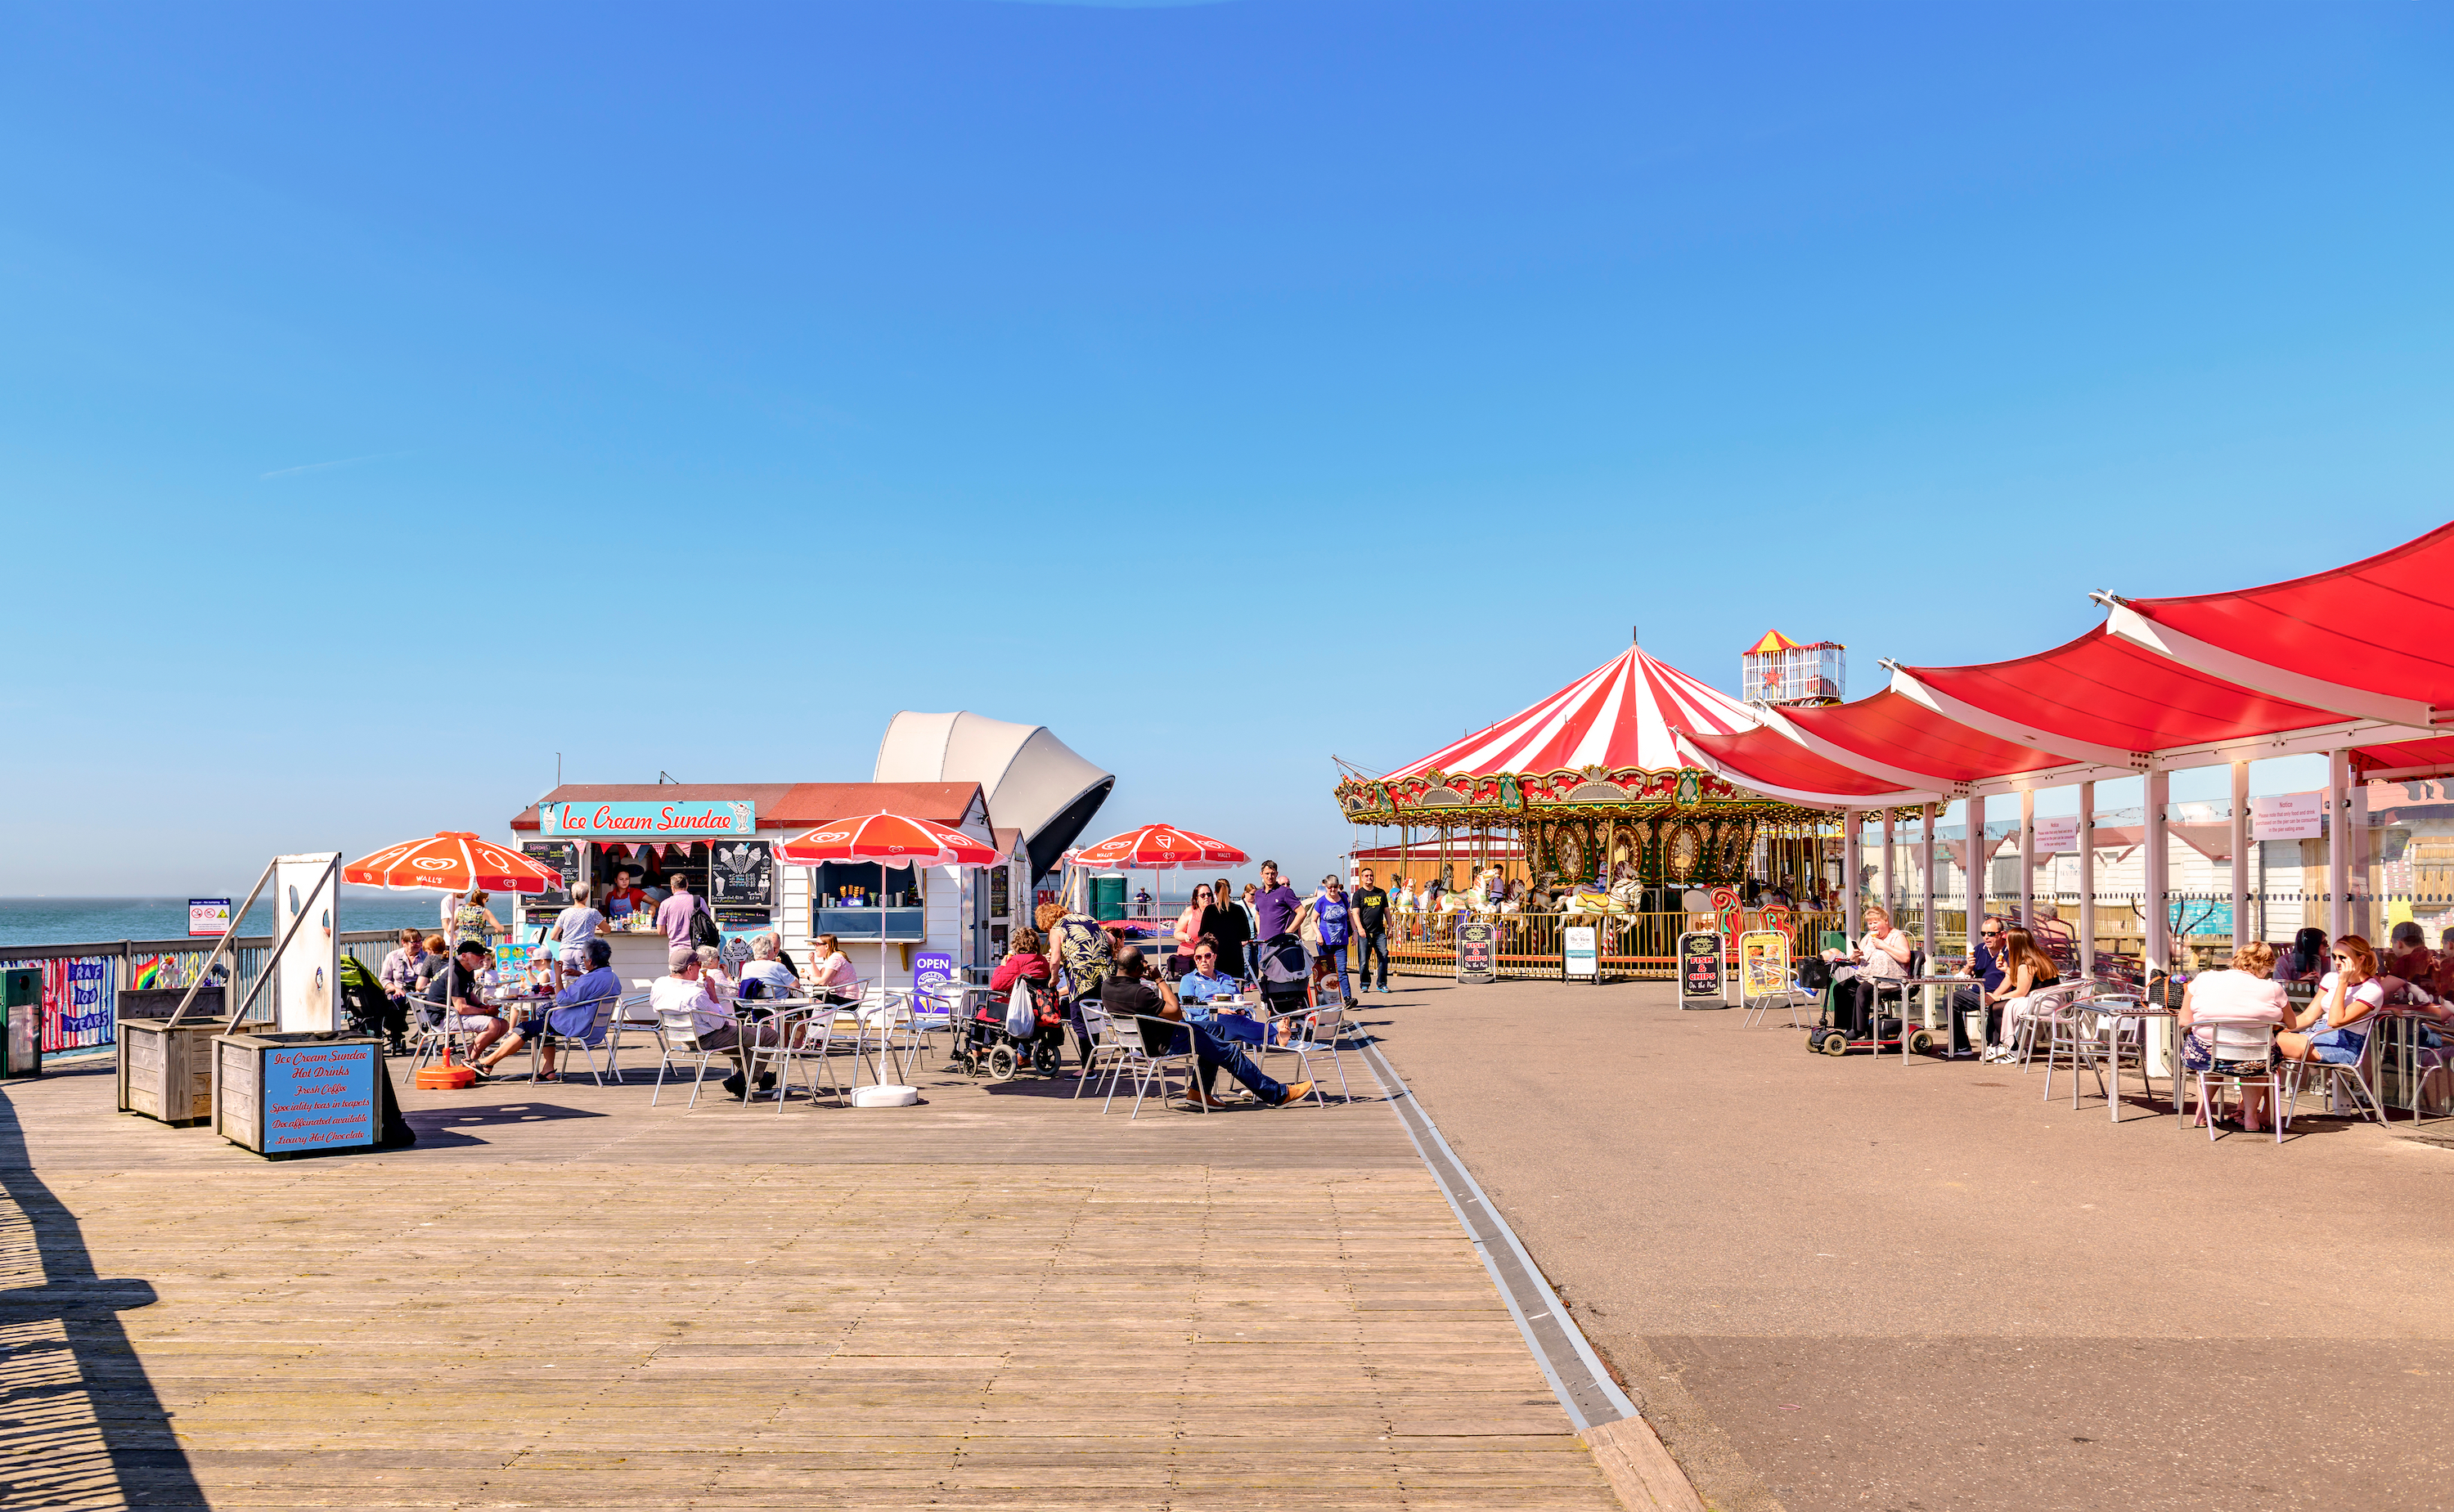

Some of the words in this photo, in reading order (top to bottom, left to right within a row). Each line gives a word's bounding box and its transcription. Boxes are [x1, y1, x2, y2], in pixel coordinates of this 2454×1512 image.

[562, 804, 586, 829] Ice
[593, 805, 652, 830] Cream
[657, 807, 730, 830] Sundae
[416, 875, 443, 884] WALL'S
[750, 923, 772, 931] Sundae
[917, 958, 949, 969] OPEN
[1698, 964, 1707, 972] &
[76, 966, 101, 980] RAF
[1689, 973, 1716, 981] CHIPS
[78, 989, 97, 1003] 100
[69, 1012, 107, 1030] YEARS
[273, 1053, 291, 1065] Ice
[292, 1052, 327, 1066] Cream
[328, 1049, 367, 1062] Sundae
[292, 1067, 311, 1078] Hot
[313, 1066, 349, 1078] Drinks
[294, 1085, 320, 1096] Fresh
[321, 1084, 347, 1095] Coffee
[270, 1101, 312, 1114] Speciality
[313, 1101, 330, 1110] teas
[331, 1100, 340, 1108] in
[342, 1098, 369, 1109] teapots
[272, 1116, 332, 1129] Decaffeinated
[332, 1114, 367, 1124] available
[275, 1135, 307, 1145] Luxury
[309, 1133, 325, 1142] Hot
[326, 1131, 364, 1143] Chocolate
